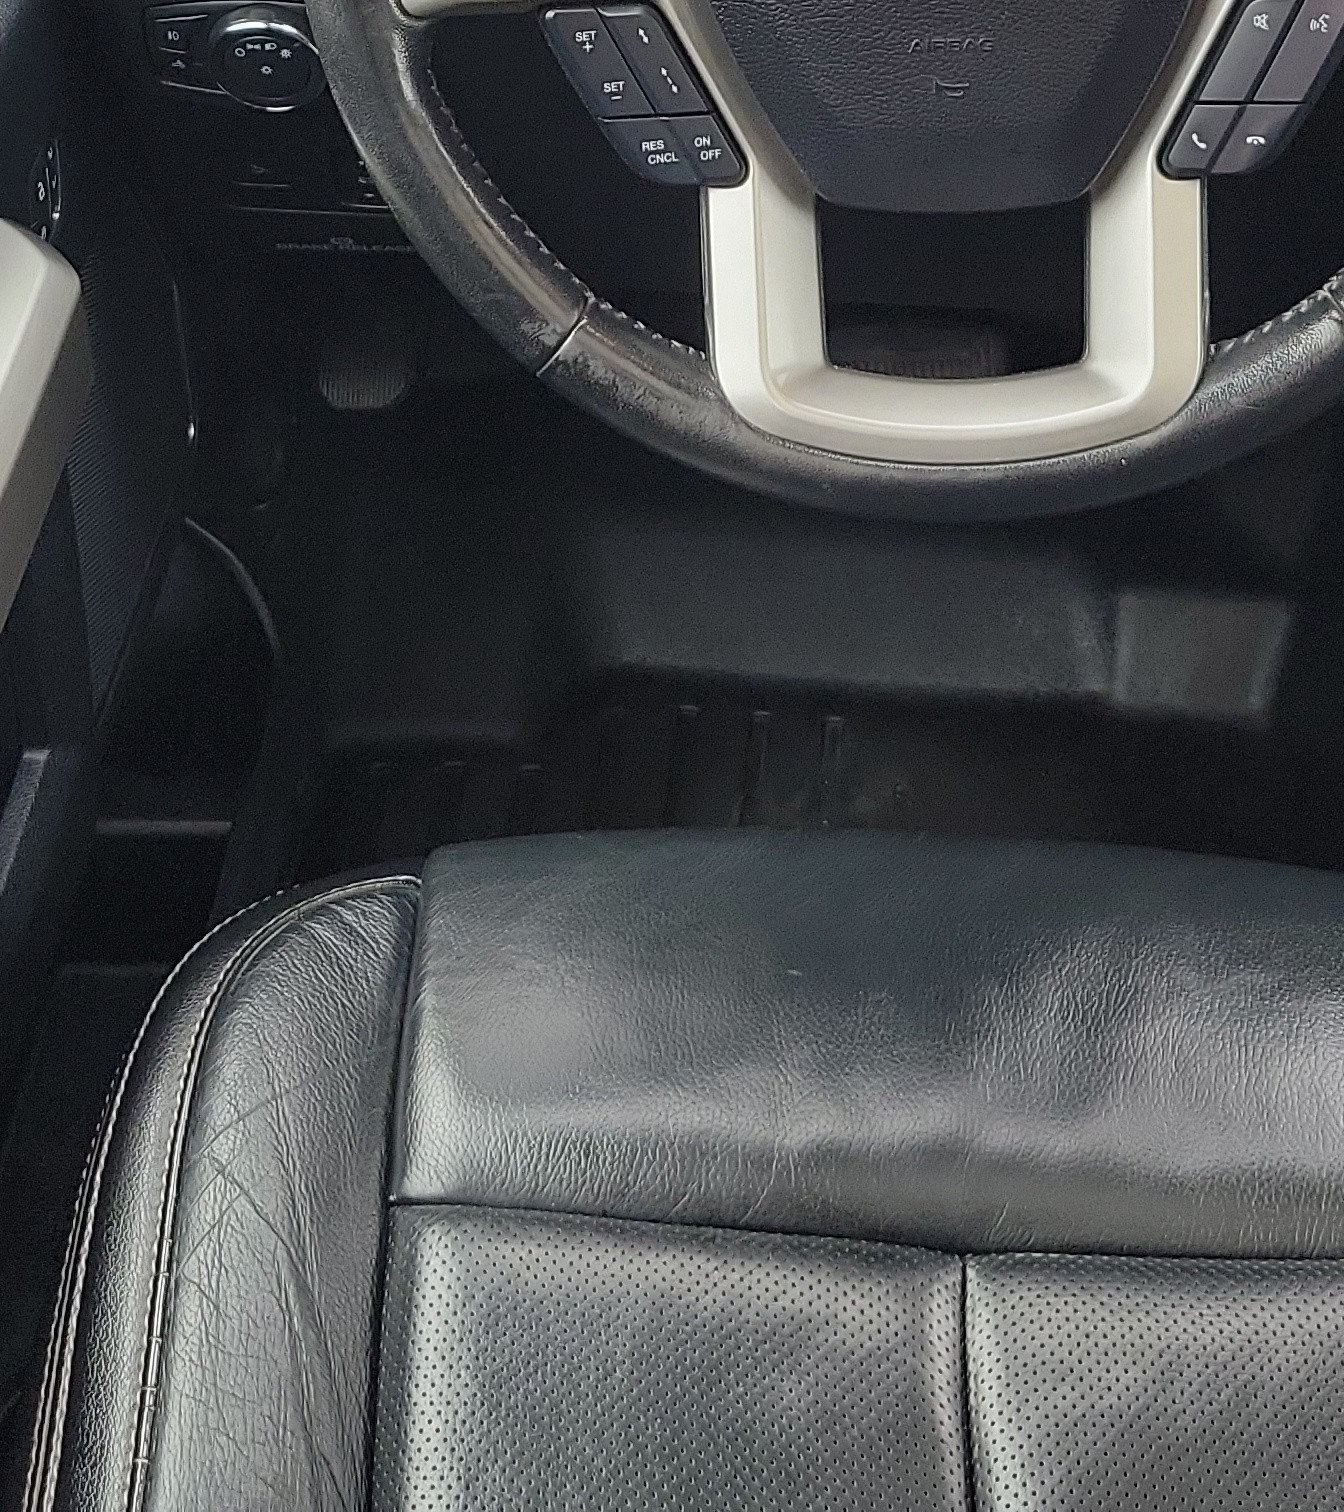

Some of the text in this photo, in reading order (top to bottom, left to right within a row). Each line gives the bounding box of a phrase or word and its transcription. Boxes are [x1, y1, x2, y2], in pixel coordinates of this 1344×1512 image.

[574, 30, 598, 42] SET
[602, 81, 626, 93] SET
[641, 140, 665, 152] RES
[693, 136, 712, 148] ON
[647, 152, 680, 166] CNCL
[699, 149, 723, 161] OFF
